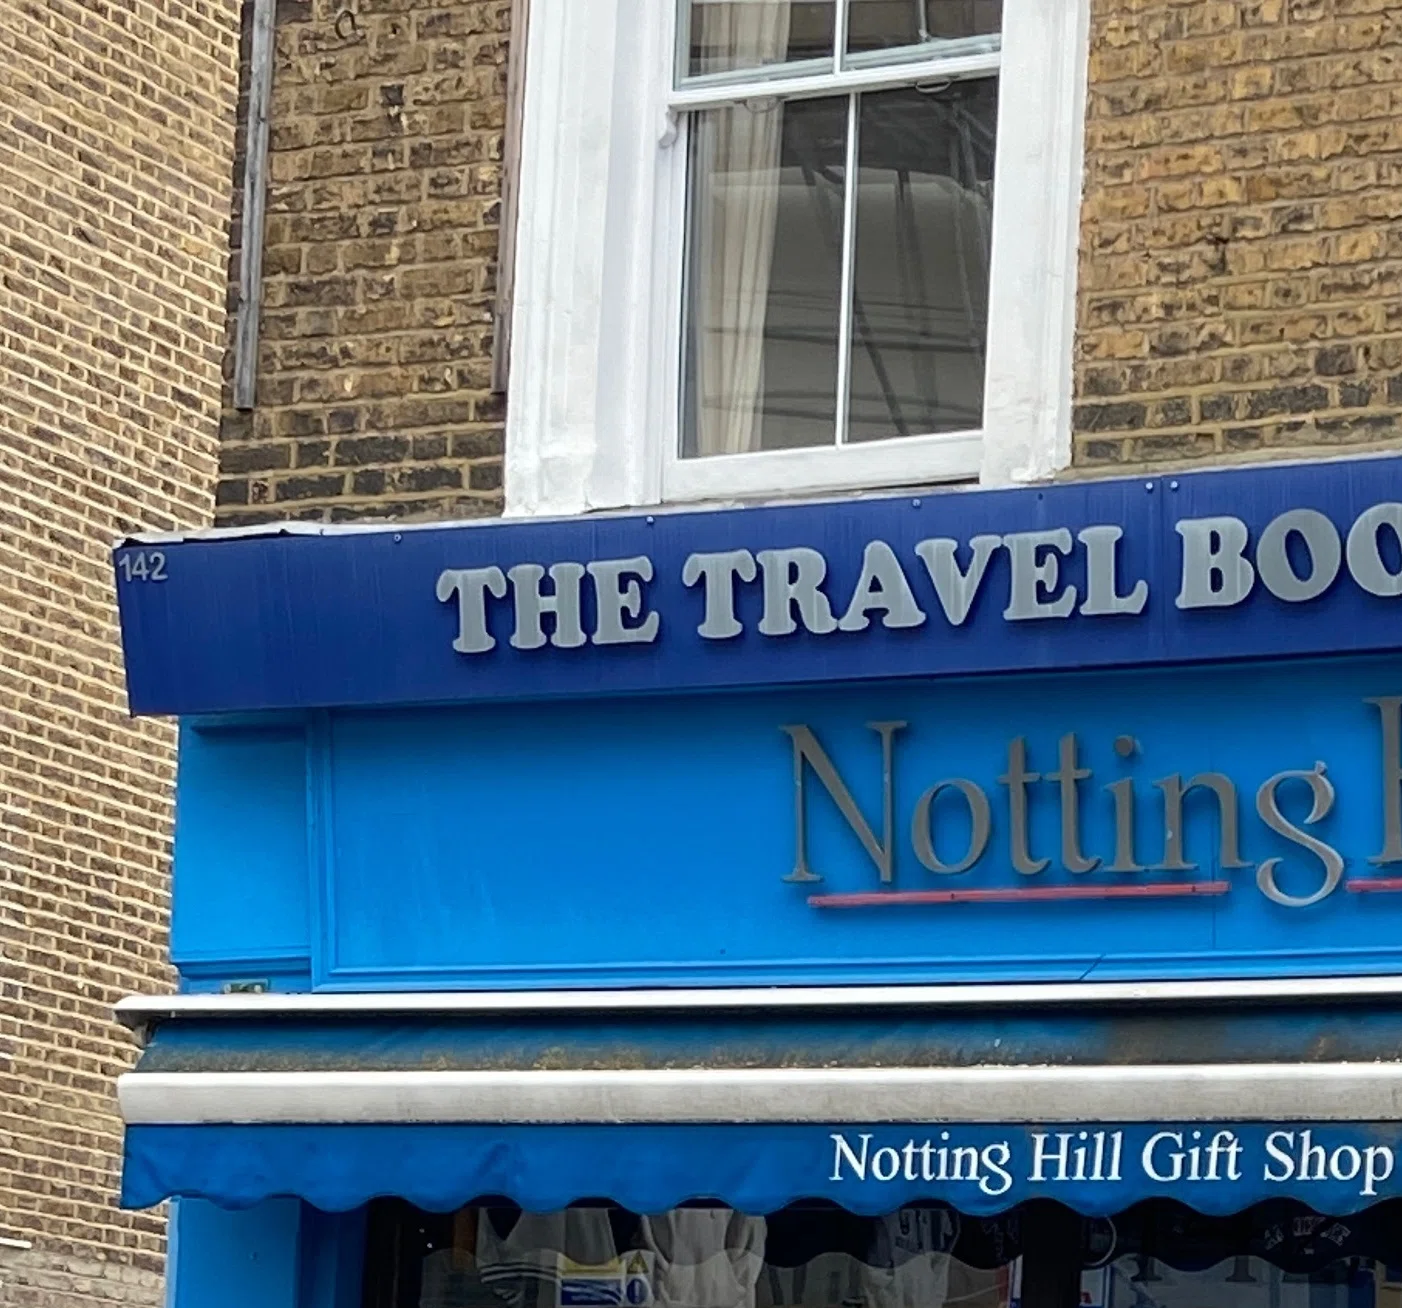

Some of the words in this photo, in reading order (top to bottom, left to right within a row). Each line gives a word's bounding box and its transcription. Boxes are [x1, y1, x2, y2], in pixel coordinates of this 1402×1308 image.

[117, 550, 168, 584] 142
[436, 554, 660, 654] THE
[683, 526, 1147, 640] TRAVEL
[781, 720, 1344, 908] Notting
[829, 1132, 1012, 1195] Notting
[1028, 1131, 1122, 1182] Hill
[1142, 1130, 1243, 1182] Gift
[1264, 1131, 1394, 1196] Shop
